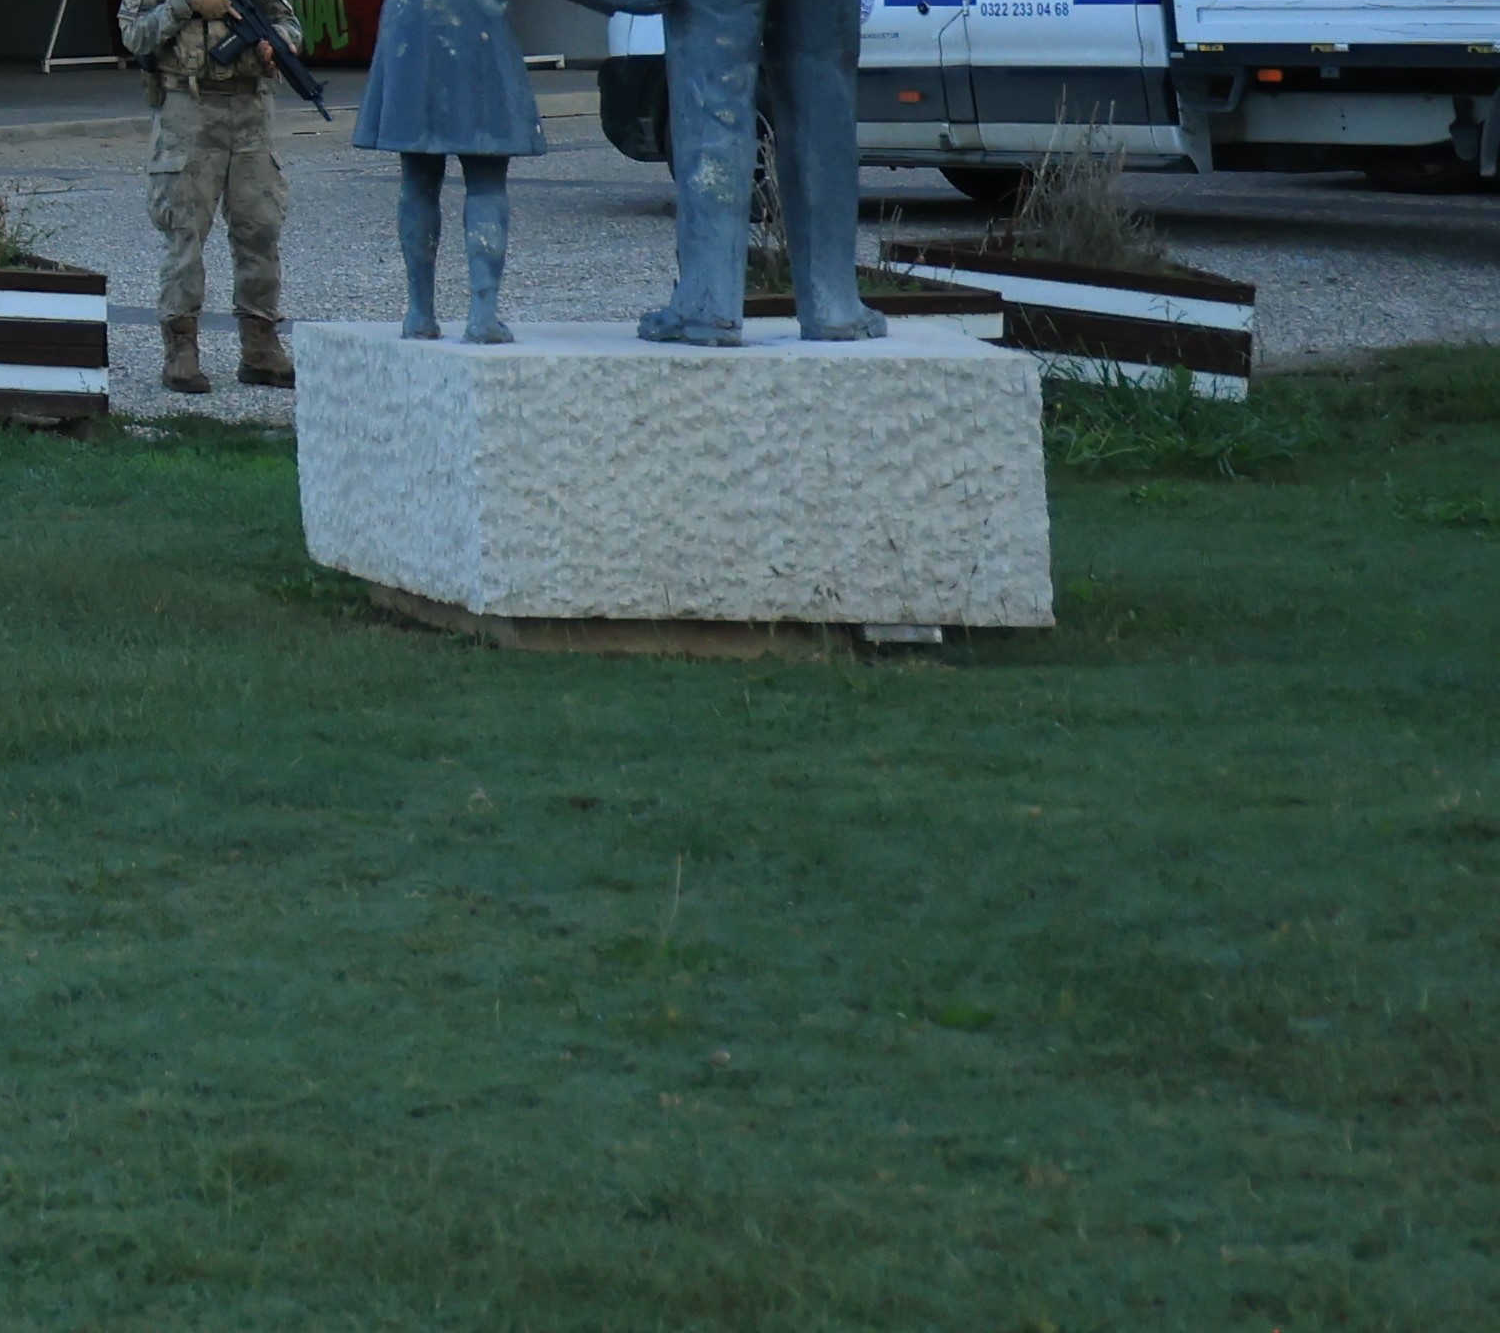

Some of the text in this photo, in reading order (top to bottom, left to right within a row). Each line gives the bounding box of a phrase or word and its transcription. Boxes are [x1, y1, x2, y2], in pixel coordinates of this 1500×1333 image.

[980, 2, 1070, 17] 0322 233 04 68
